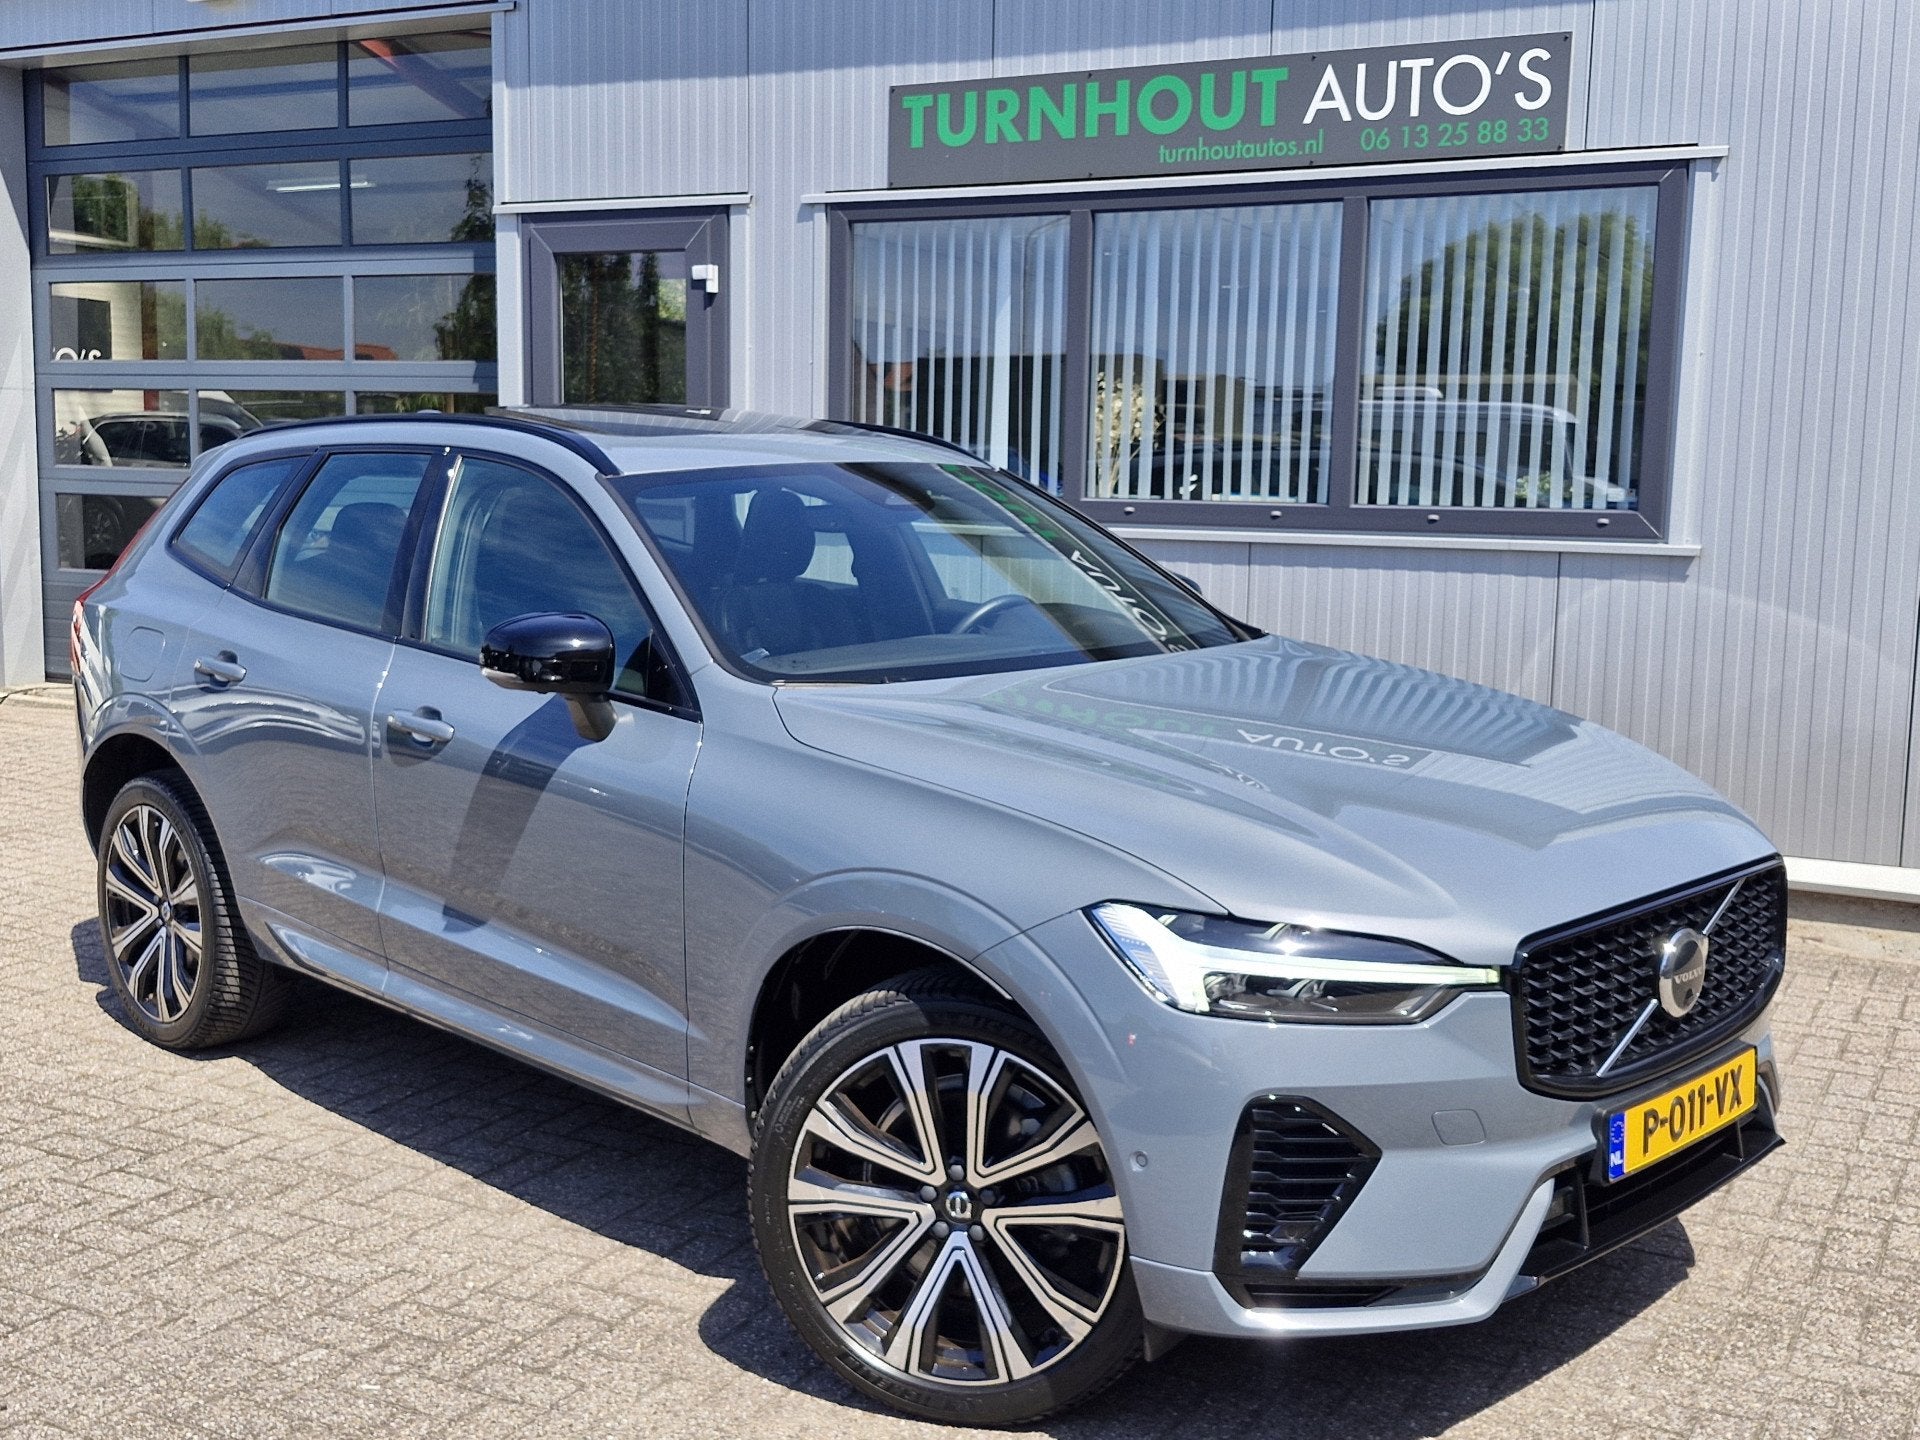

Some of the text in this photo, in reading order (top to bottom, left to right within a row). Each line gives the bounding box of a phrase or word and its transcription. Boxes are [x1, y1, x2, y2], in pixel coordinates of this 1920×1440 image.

[902, 48, 1552, 149] TURNHOUT AUTO'S
[1158, 117, 1550, 163] turnhoutautos.nl 06 13 25 88 33
[1673, 966, 1703, 984] VOLV
[1642, 1064, 1743, 1157] P-011-VX
[1609, 1150, 1624, 1168] NL
